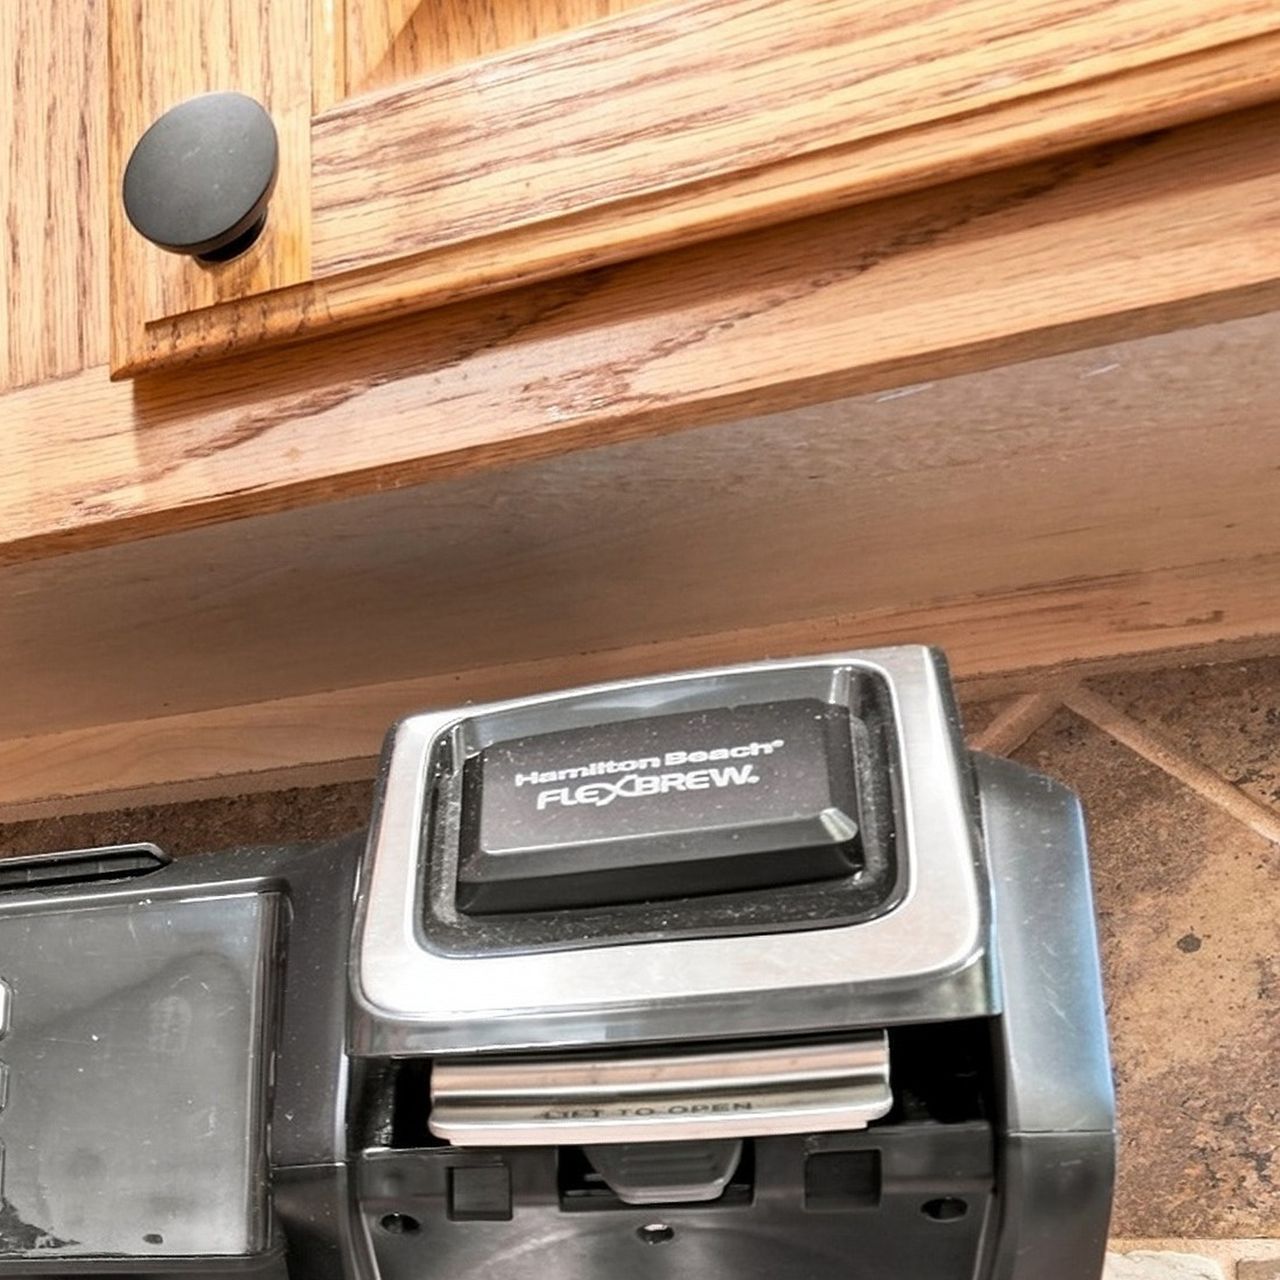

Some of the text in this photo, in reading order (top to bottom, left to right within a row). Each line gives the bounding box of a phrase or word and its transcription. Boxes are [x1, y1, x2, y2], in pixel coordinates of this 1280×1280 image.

[514, 755, 661, 787] Hamilton
[619, 1107, 655, 1116] TO
[667, 1101, 753, 1115] OPEN
